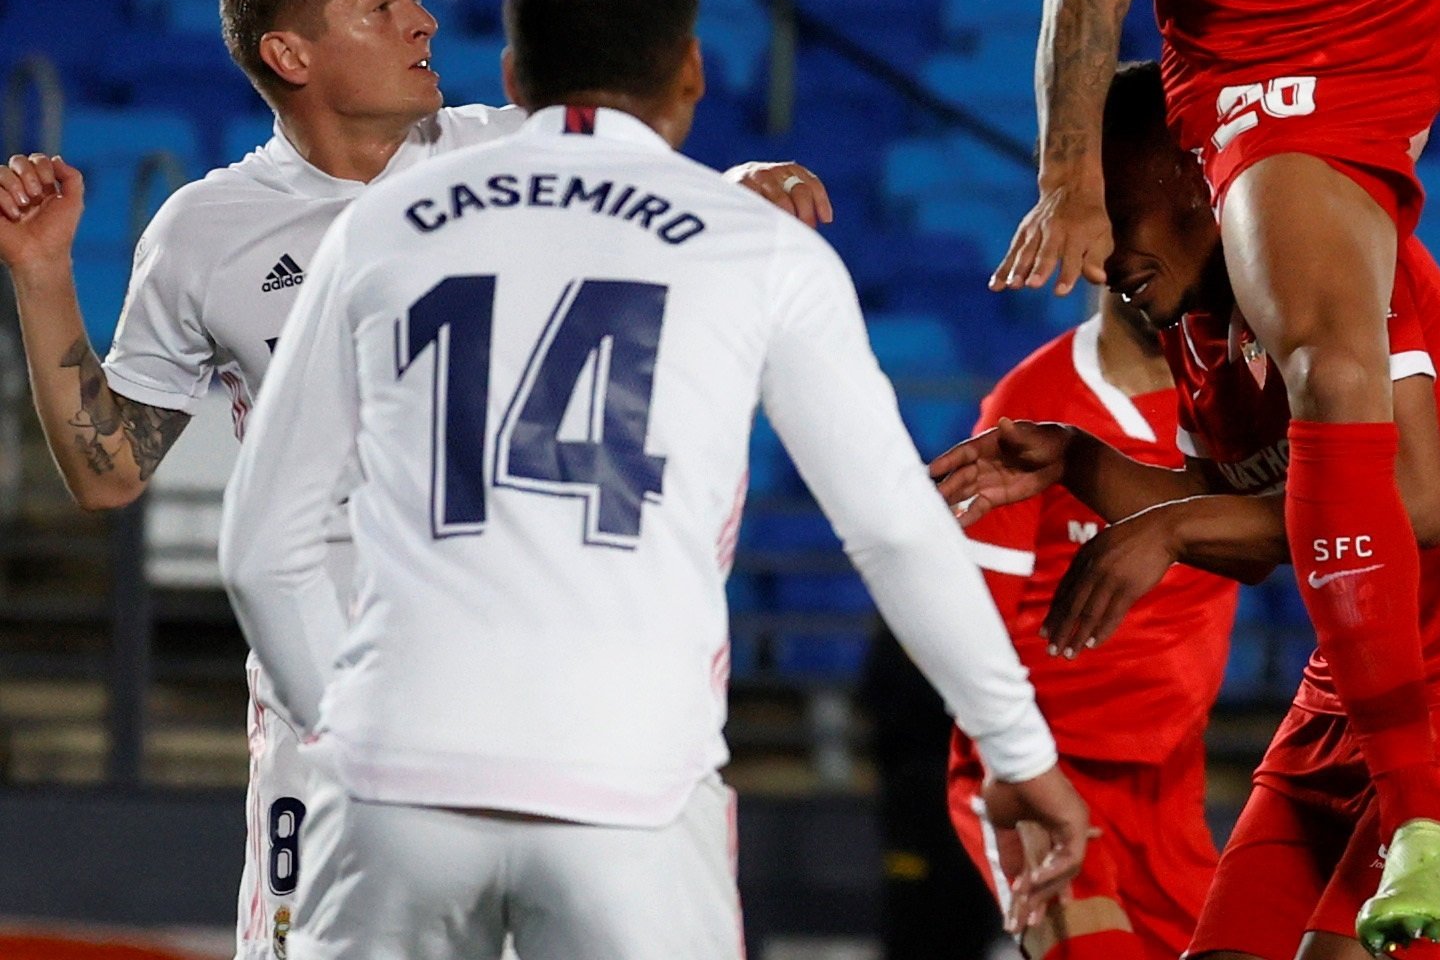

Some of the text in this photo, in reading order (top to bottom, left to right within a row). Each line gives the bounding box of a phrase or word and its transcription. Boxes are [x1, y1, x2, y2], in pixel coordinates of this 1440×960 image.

[1210, 76, 1317, 153] 20
[405, 173, 708, 246] CASEMIRO
[261, 273, 306, 293] adida
[393, 273, 671, 552] 14
[267, 796, 307, 897] 8
